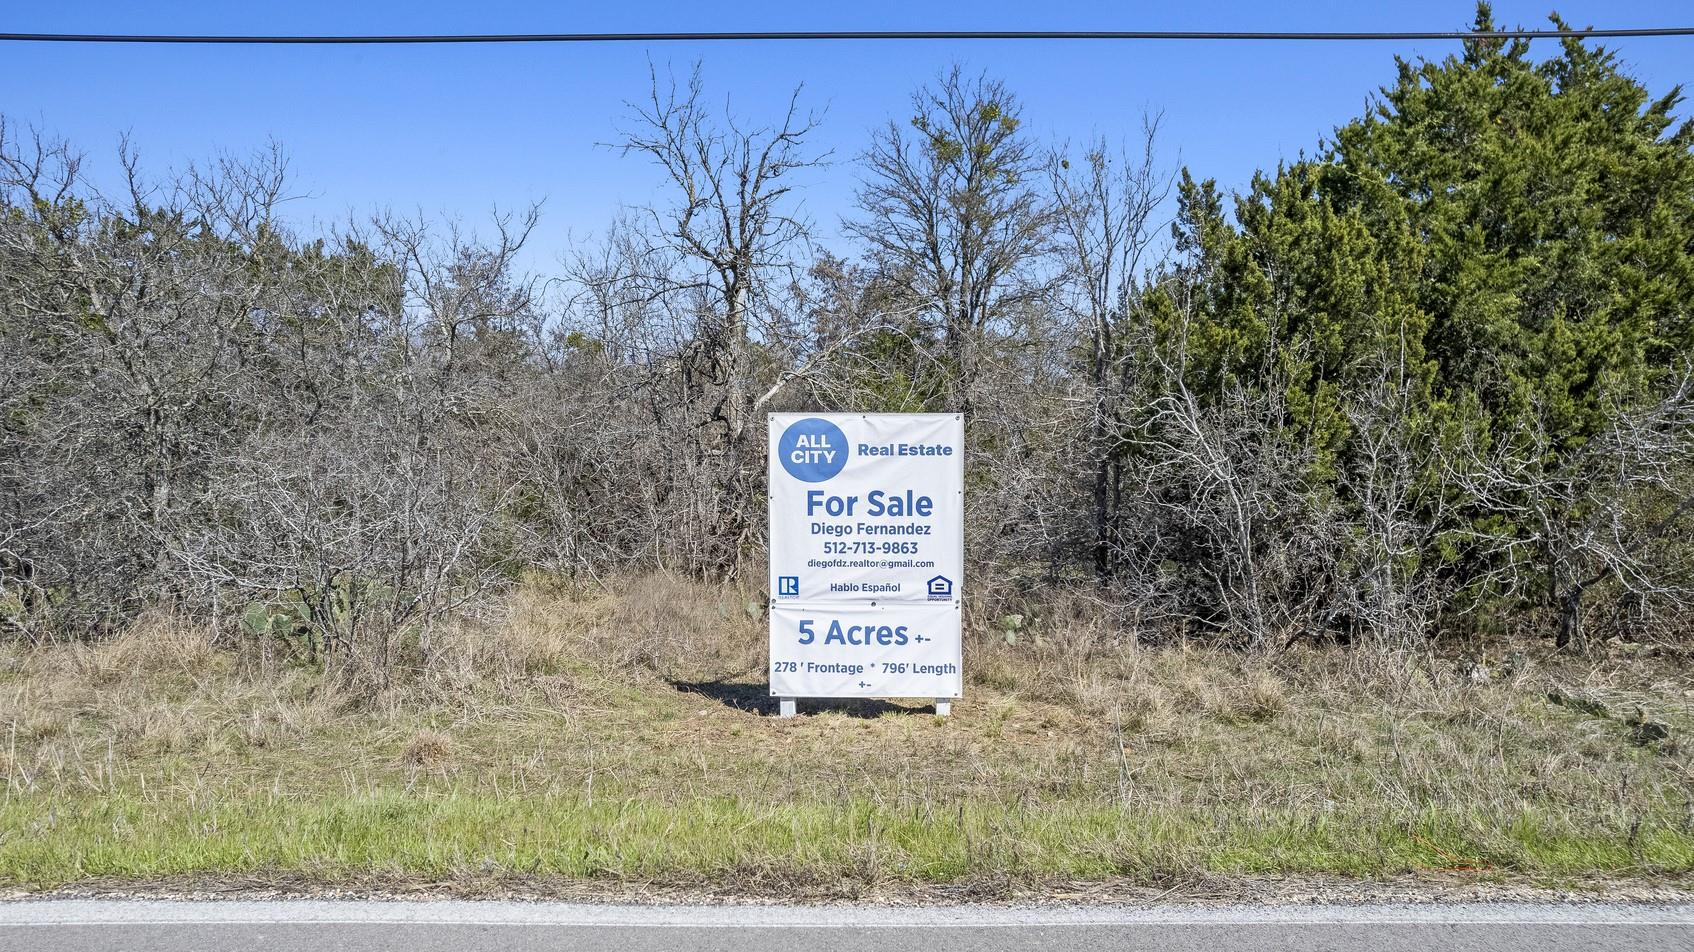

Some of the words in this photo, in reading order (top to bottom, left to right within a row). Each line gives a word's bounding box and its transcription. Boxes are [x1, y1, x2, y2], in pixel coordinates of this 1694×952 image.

[796, 435, 831, 447] ALL
[858, 444, 894, 456] Real
[898, 444, 953, 456] Estate
[791, 451, 836, 464] CITY
[807, 491, 858, 517] For
[867, 490, 933, 517] Sale
[811, 523, 852, 537] Diego
[857, 523, 931, 535] Fernandez
[824, 542, 918, 554] 512-713-9863
[808, 560, 934, 569] diegofdz.realtor@gmail.com
[830, 583, 859, 592] Hablo
[862, 583, 901, 593] Español
[799, 620, 814, 645] 5
[824, 620, 908, 645] Acres
[774, 662, 797, 672] 278
[808, 663, 863, 675] Frontage
[882, 663, 909, 673] 796'
[913, 663, 956, 676] Length
